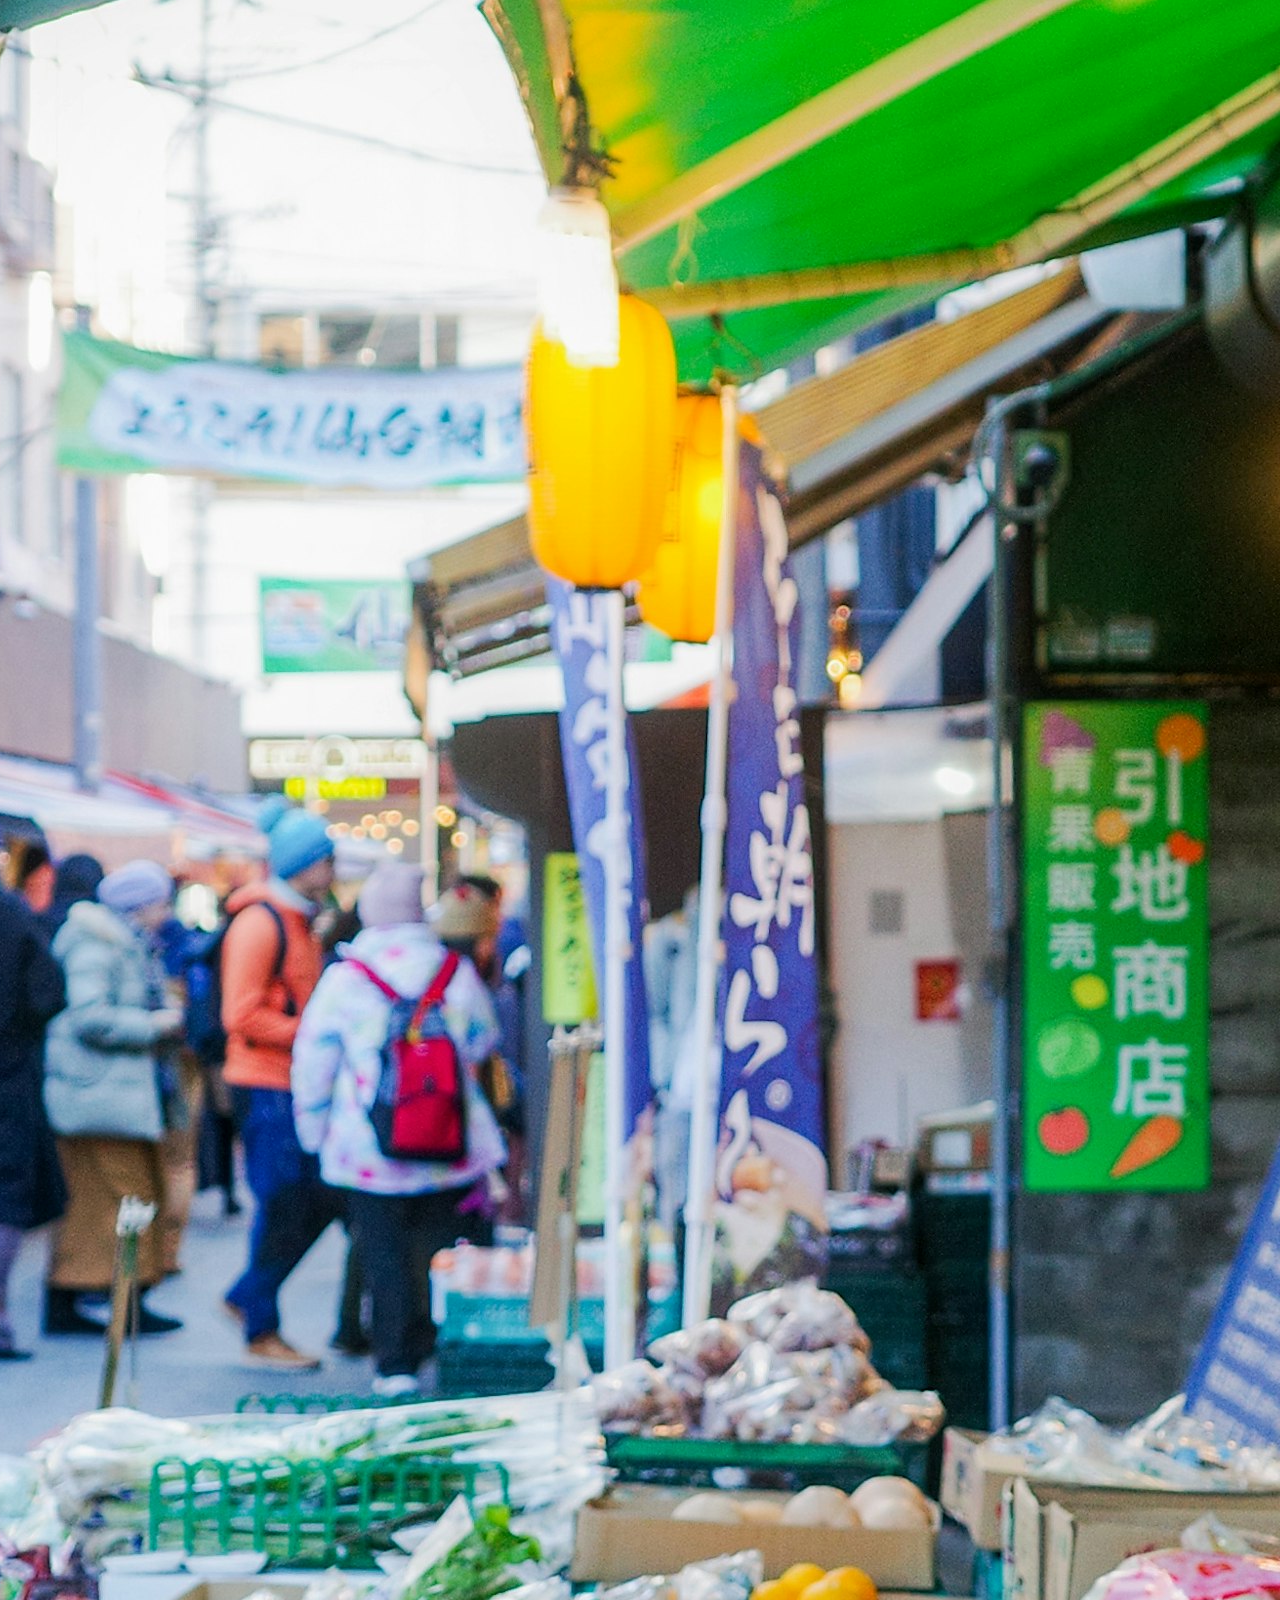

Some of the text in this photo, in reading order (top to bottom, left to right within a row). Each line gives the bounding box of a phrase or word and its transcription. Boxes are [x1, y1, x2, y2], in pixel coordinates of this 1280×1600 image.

[1045, 742, 1097, 972] 青果販売
[1110, 742, 1192, 1120] 引地商店
